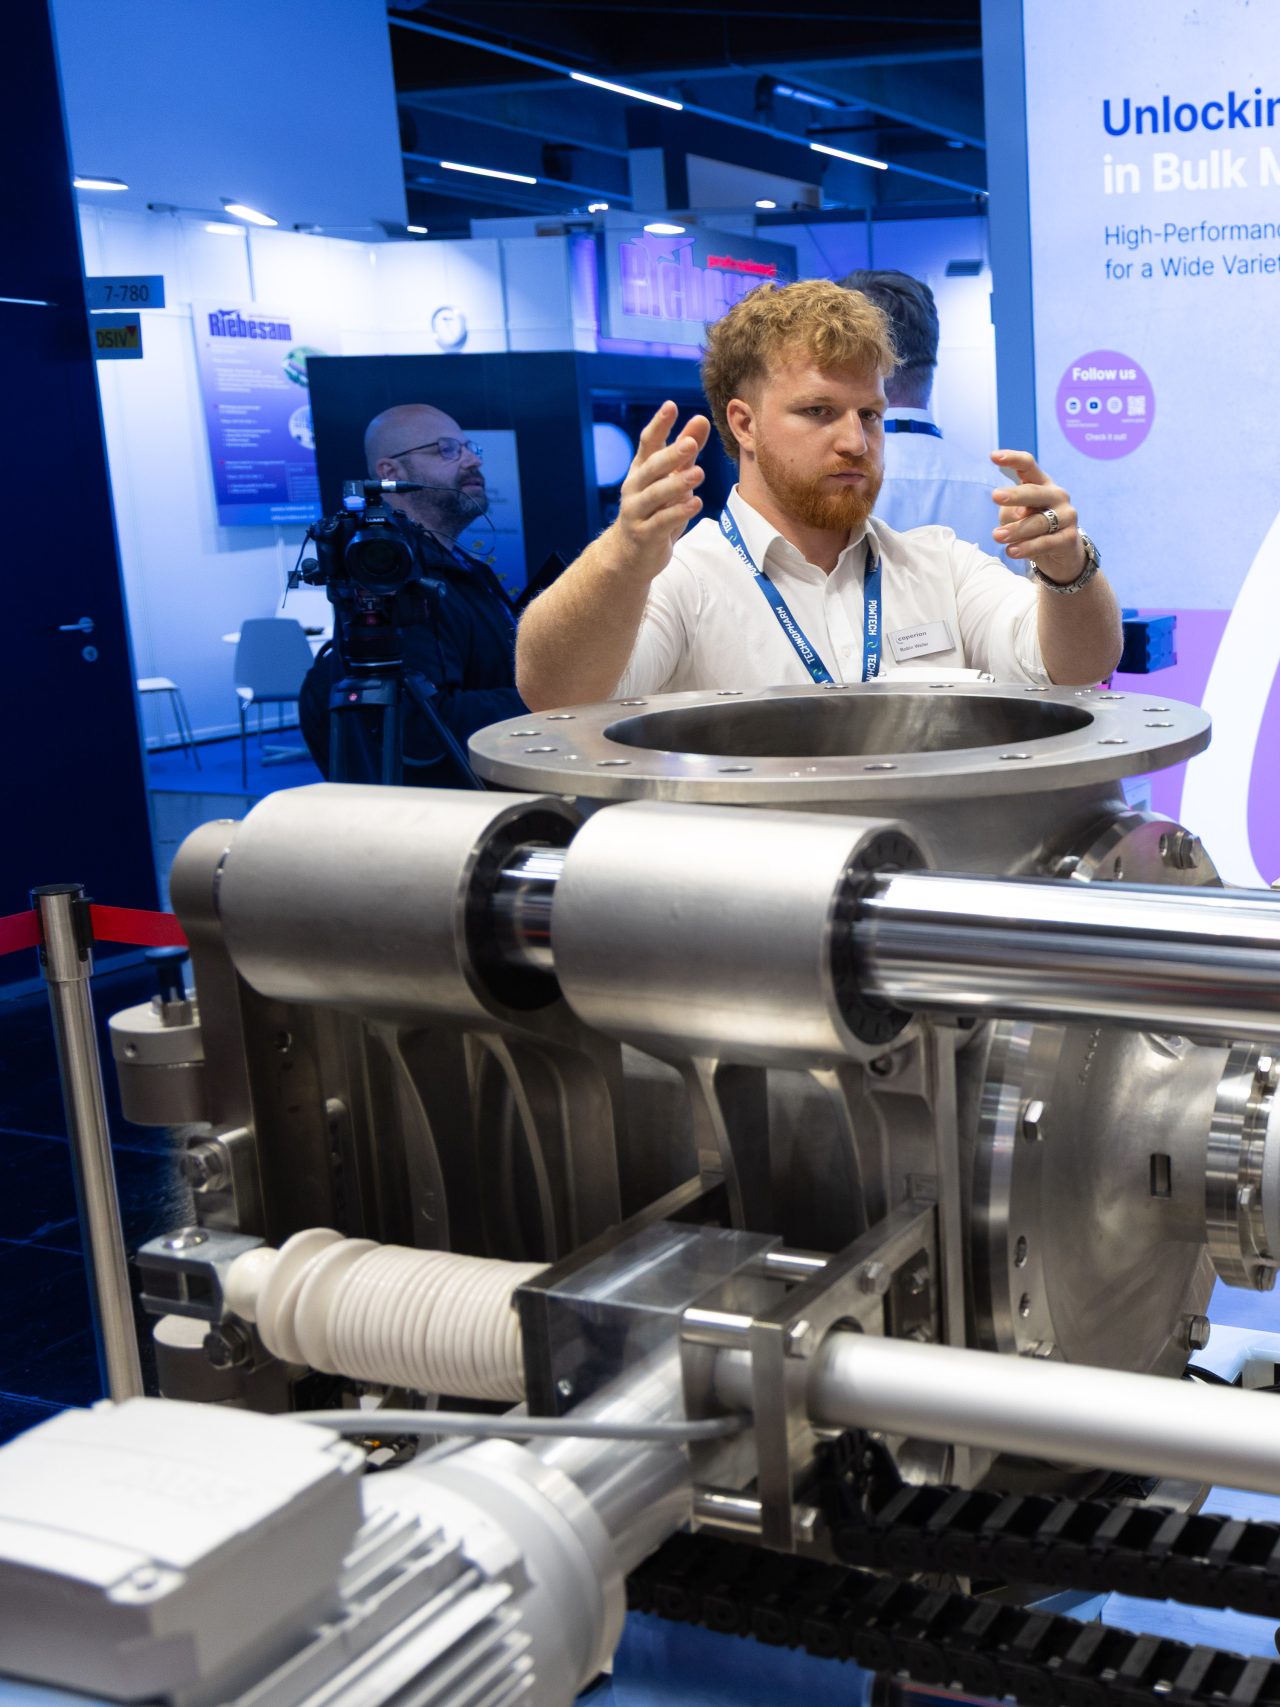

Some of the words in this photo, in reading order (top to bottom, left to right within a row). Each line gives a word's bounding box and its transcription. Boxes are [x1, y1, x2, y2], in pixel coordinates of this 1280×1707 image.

[1103, 153, 1141, 195] in
[1152, 148, 1248, 193] Bulk
[1105, 258, 1133, 280] for
[1141, 261, 1153, 278] a
[1160, 254, 1214, 277] Wide
[104, 284, 149, 303] 7-780
[208, 309, 292, 341] Riebesam
[1072, 367, 1117, 381] Follow
[1119, 369, 1137, 380] us
[868, 600, 878, 636] POWTECH
[776, 606, 816, 665] TECHNOPHARM
